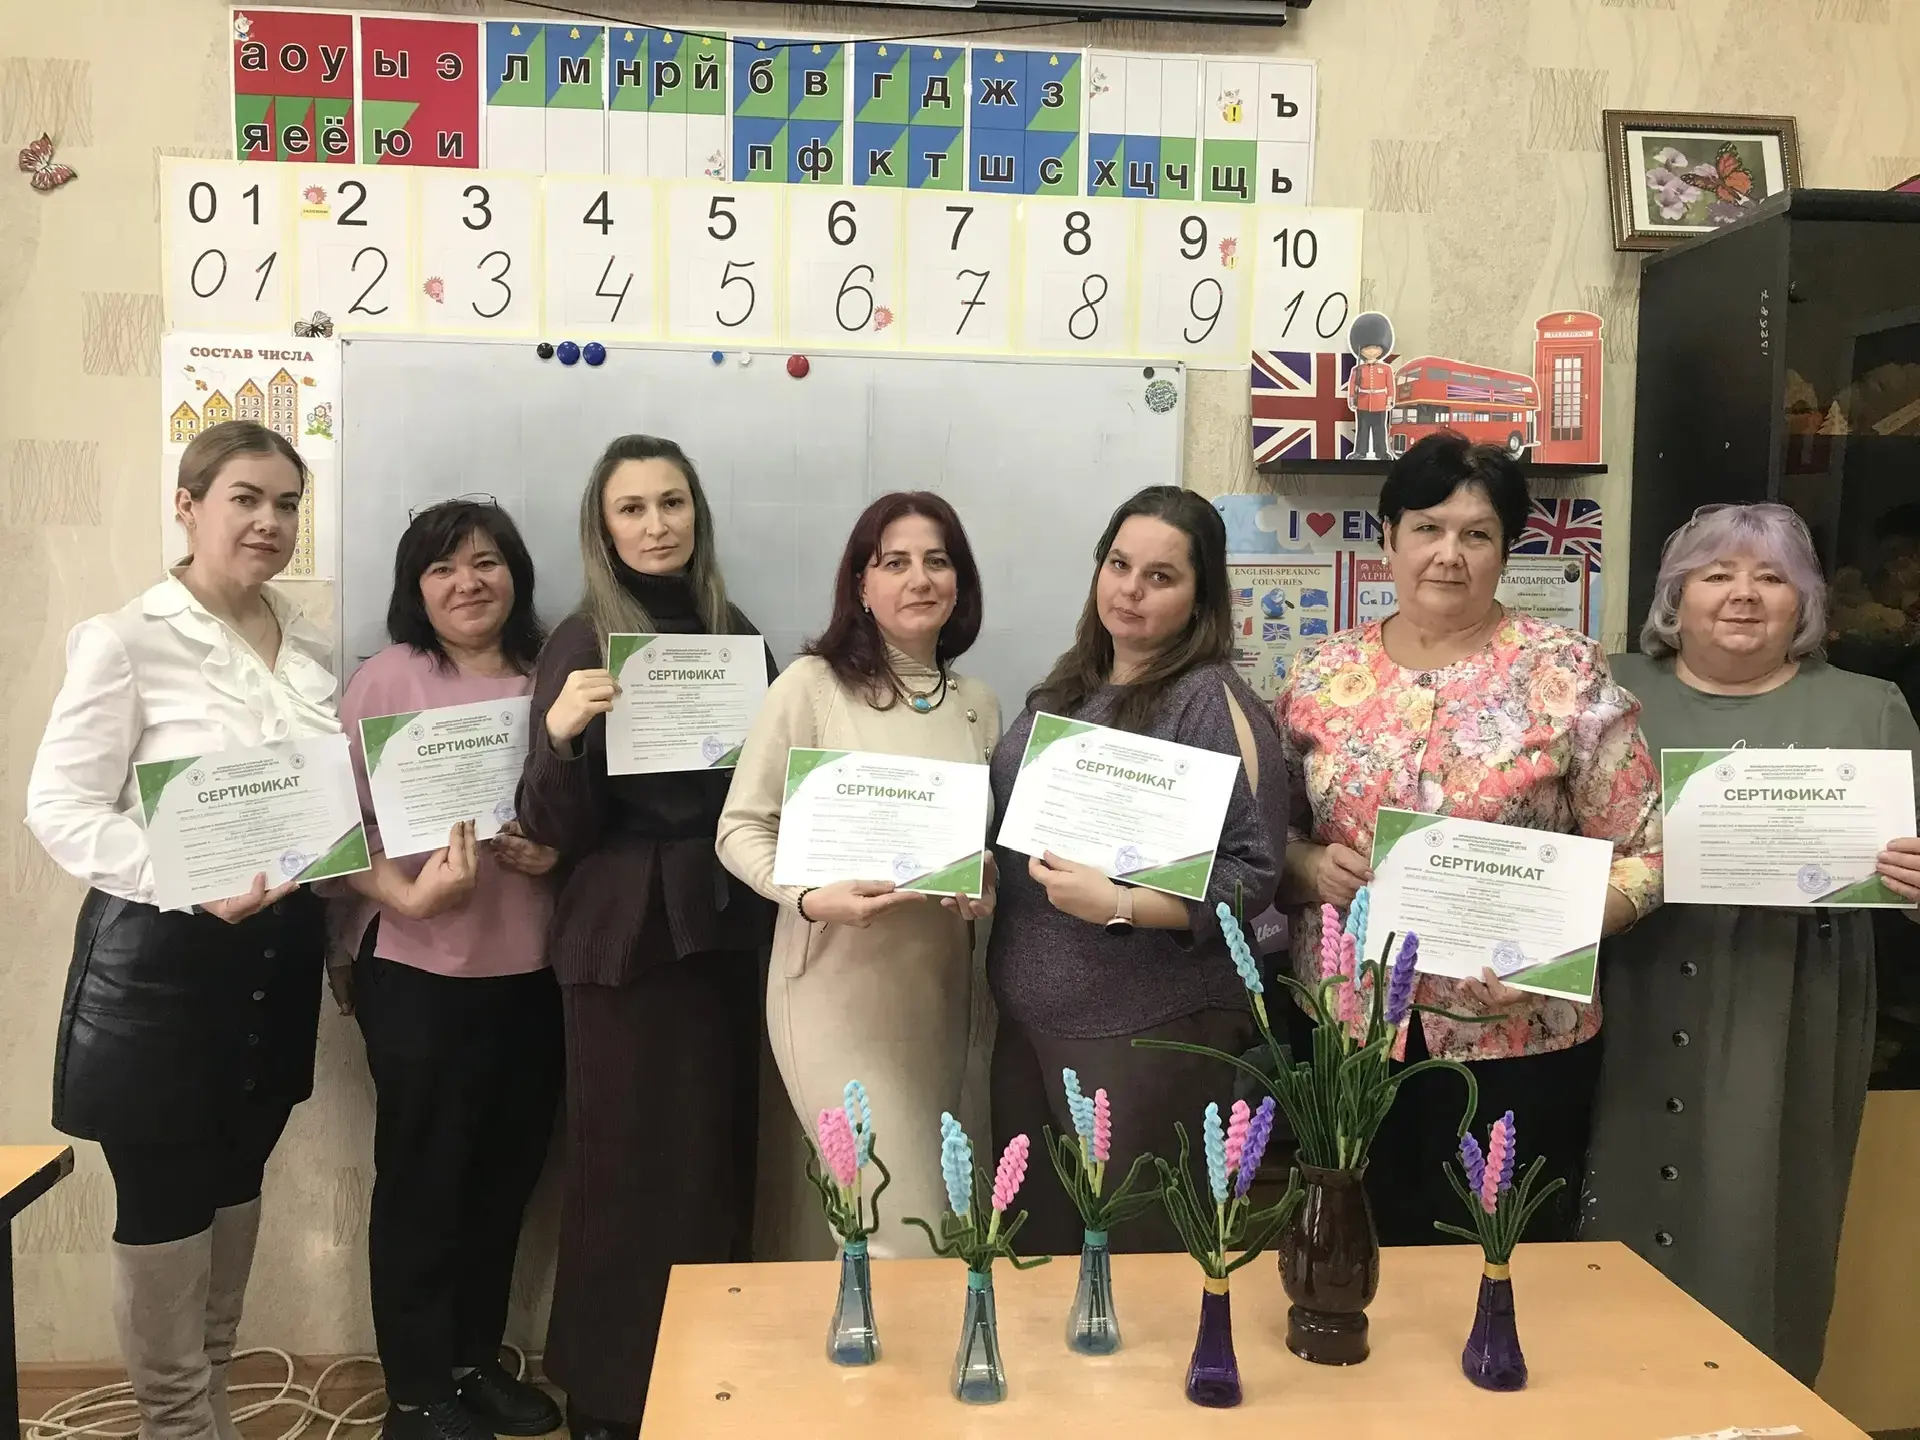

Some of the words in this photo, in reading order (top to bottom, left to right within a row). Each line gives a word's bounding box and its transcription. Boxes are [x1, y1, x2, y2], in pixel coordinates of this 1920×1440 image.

[241, 43, 267, 70] а
[280, 44, 307, 72] о
[320, 46, 346, 82] у
[375, 50, 407, 77] ы
[437, 53, 462, 80] э
[502, 55, 528, 82] л
[560, 57, 590, 84] м
[617, 60, 641, 87] н
[655, 61, 681, 96] р
[694, 54, 718, 90] й
[749, 59, 774, 94] б
[805, 71, 828, 96] в
[873, 73, 893, 98] г
[922, 76, 951, 109] д
[980, 79, 1017, 105] ж
[1042, 82, 1064, 108] з
[1270, 93, 1299, 118] ъ
[243, 124, 269, 151] я
[283, 125, 309, 153] е
[322, 118, 348, 155] ё
[374, 129, 411, 156] ю
[439, 132, 462, 158] и
[749, 145, 772, 170] п
[797, 138, 833, 181] ф
[870, 150, 894, 176] к
[924, 153, 947, 178] т
[980, 156, 1014, 183] ш
[1039, 158, 1063, 185] с
[1094, 160, 1117, 187] х
[1130, 162, 1154, 195] ц
[1166, 164, 1188, 190] ч
[1212, 166, 1247, 199] щ
[1271, 168, 1293, 194] ь
[188, 181, 217, 224] 0
[242, 184, 259, 225] 1
[336, 180, 368, 227] 2
[462, 184, 492, 231] 3
[582, 190, 614, 236] 4
[707, 196, 737, 240] 5
[827, 200, 857, 246] 6
[945, 205, 974, 251] 7
[1063, 210, 1092, 256] 8
[1179, 215, 1208, 260] 9
[1273, 228, 1318, 269] 10
[191, 248, 227, 298] 0
[255, 251, 277, 301] 1
[348, 246, 389, 316] 2
[471, 250, 512, 319] 3
[595, 255, 634, 323] 4
[716, 260, 755, 327] 5
[835, 264, 875, 332] 6
[955, 269, 991, 336] 7
[1068, 273, 1108, 341] 8
[1183, 277, 1223, 344] 9
[1281, 290, 1349, 339] 10
[190, 347, 254, 359] СОСТАВ
[258, 350, 313, 362] ЧИСЛА
[1289, 511, 1298, 541] I
[1359, 590, 1371, 605] C
[1380, 591, 1393, 605] D
[1501, 576, 1566, 585] БЛАГОДАРНОСТЬ
[648, 669, 726, 681] СЕРТИФИКАТ
[417, 733, 509, 757] СЕРТИФИКАТ
[198, 776, 300, 803] СЕРТИФИКАТ
[837, 784, 935, 802] СЕРТИФИКАТ
[1076, 759, 1176, 791] СЕРТИФИКАТ
[1723, 789, 1847, 801] СЕРТИФИКАТ
[1429, 854, 1544, 881] СЕРТИФИКАТ
